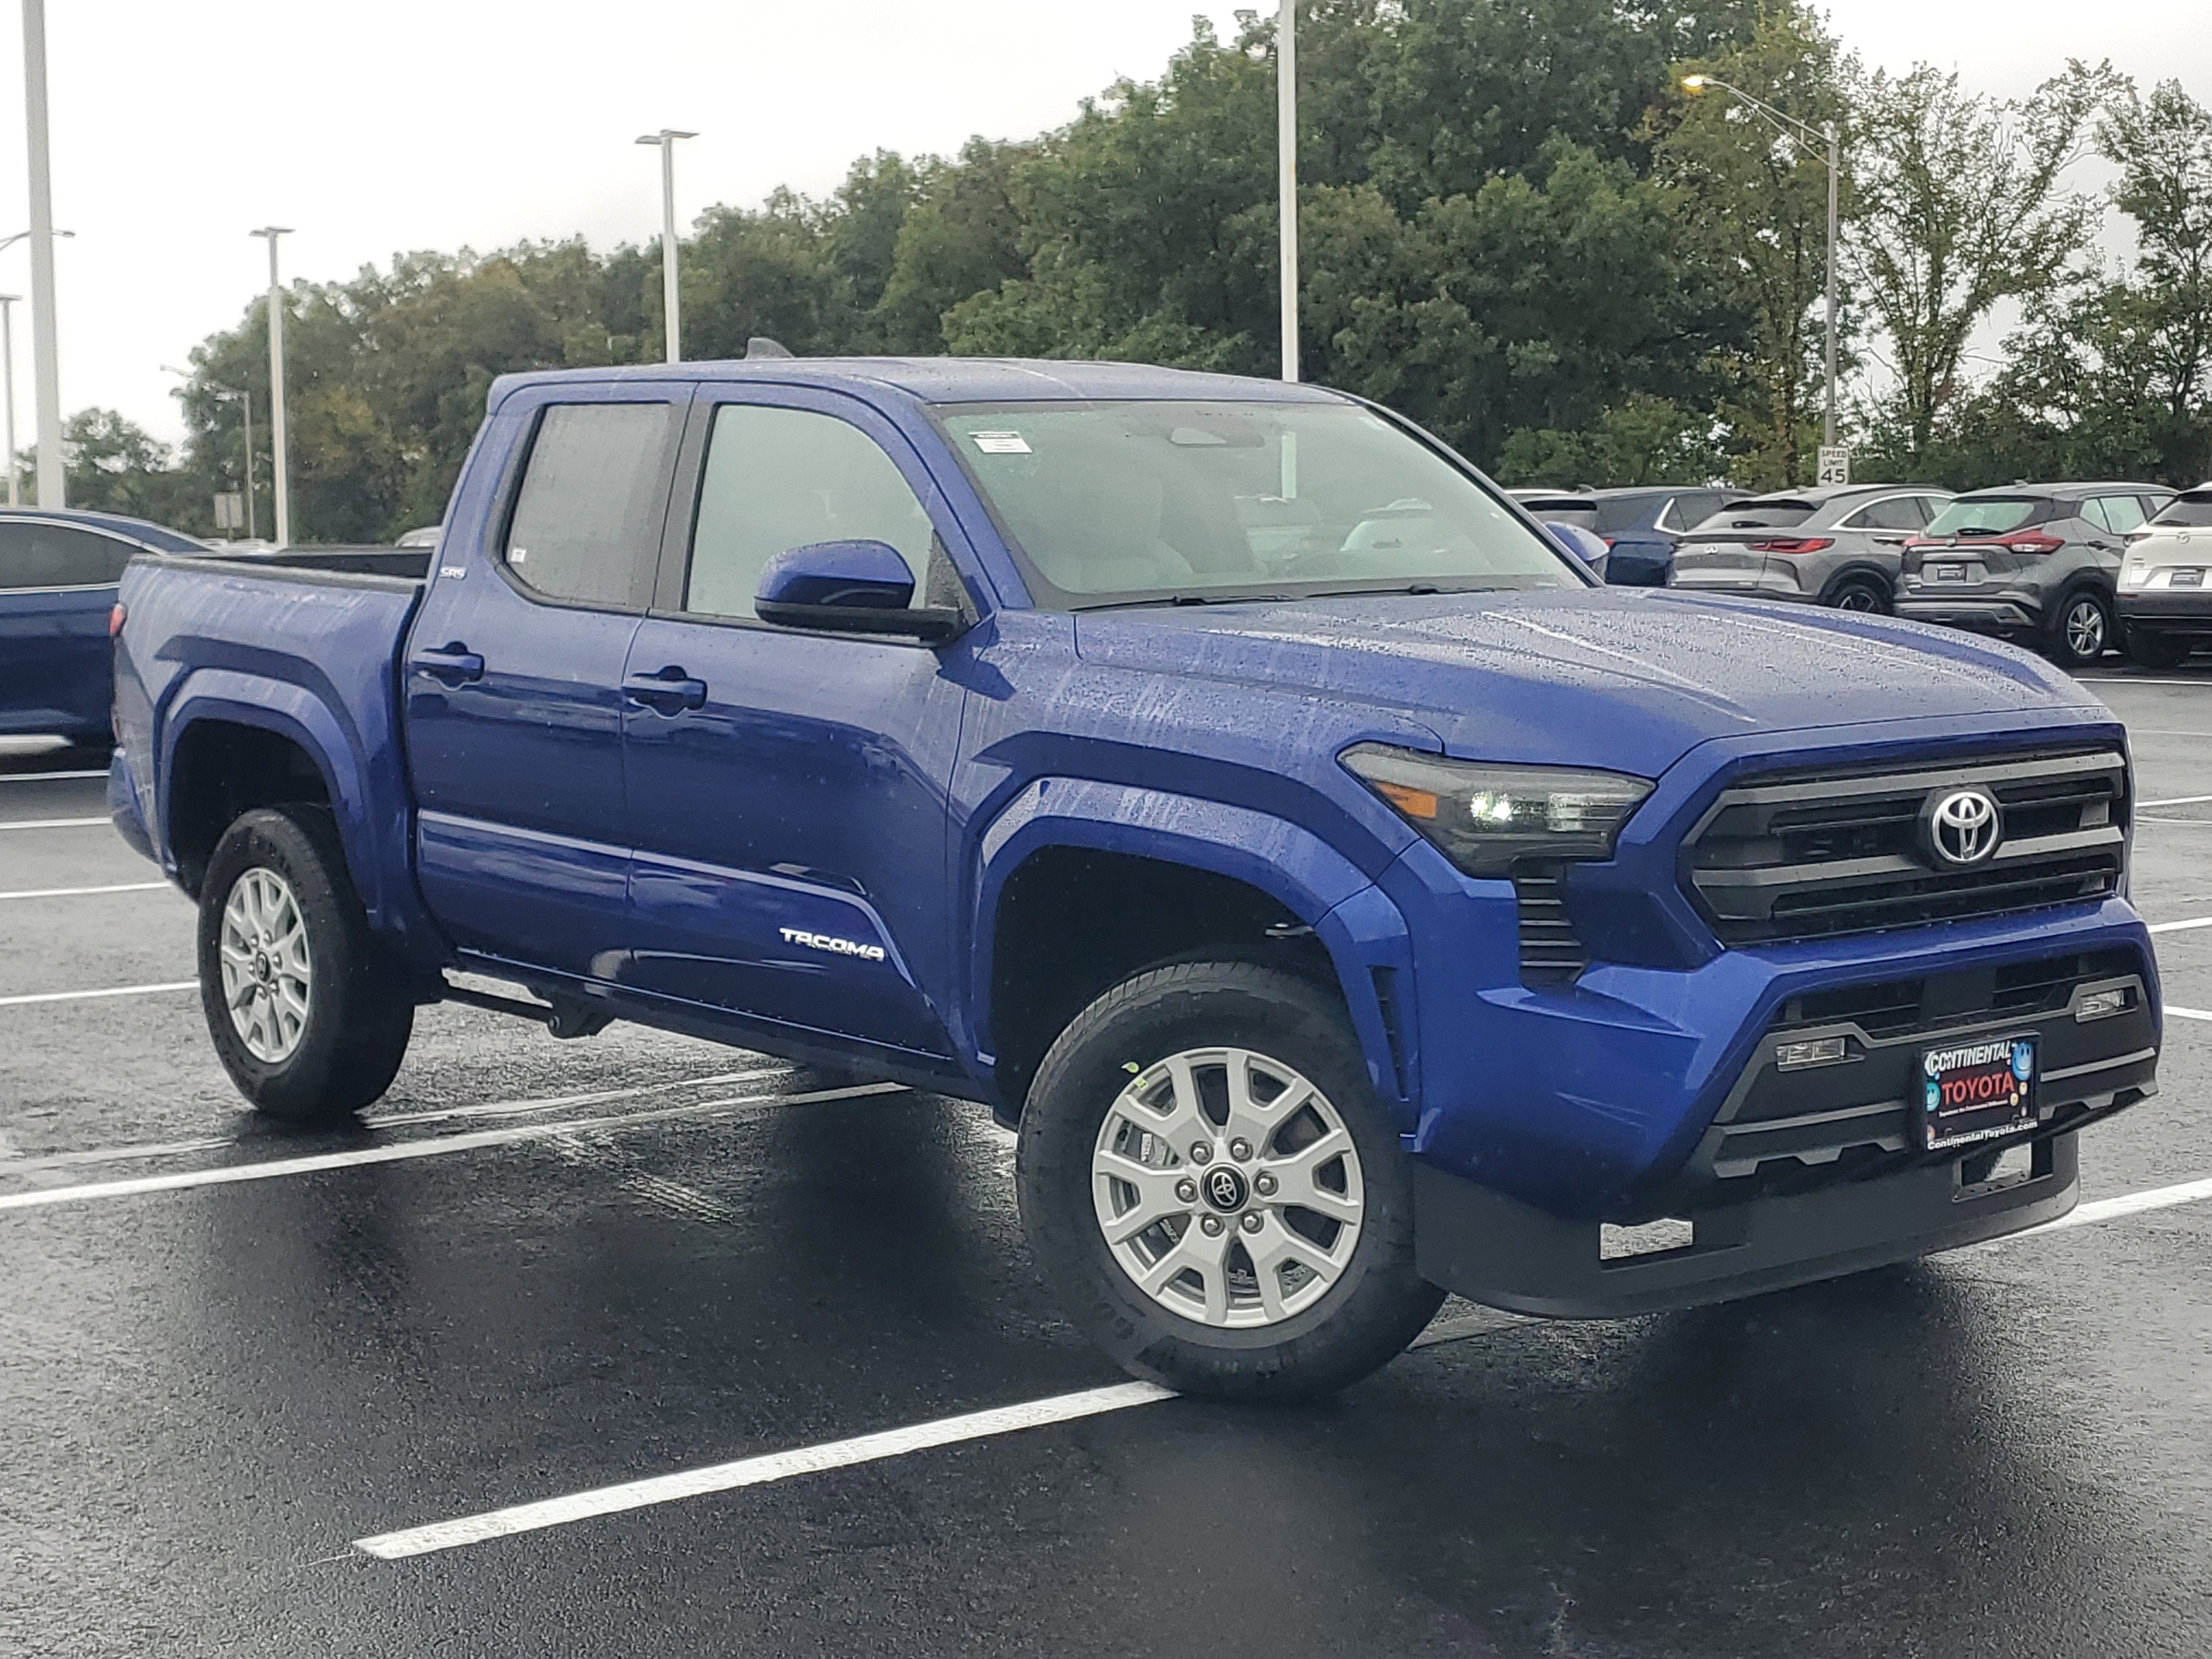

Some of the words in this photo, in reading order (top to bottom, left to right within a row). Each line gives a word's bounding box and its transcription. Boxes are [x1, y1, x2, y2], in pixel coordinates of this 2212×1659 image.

[1821, 468, 1846, 483] 45
[780, 927, 884, 962] TACOMA
[1925, 1041, 2012, 1076] CONTINENTAL
[1942, 1072, 2015, 1105] TOYOTA
[1927, 1121, 2038, 1150] ContinentalToyota.com
